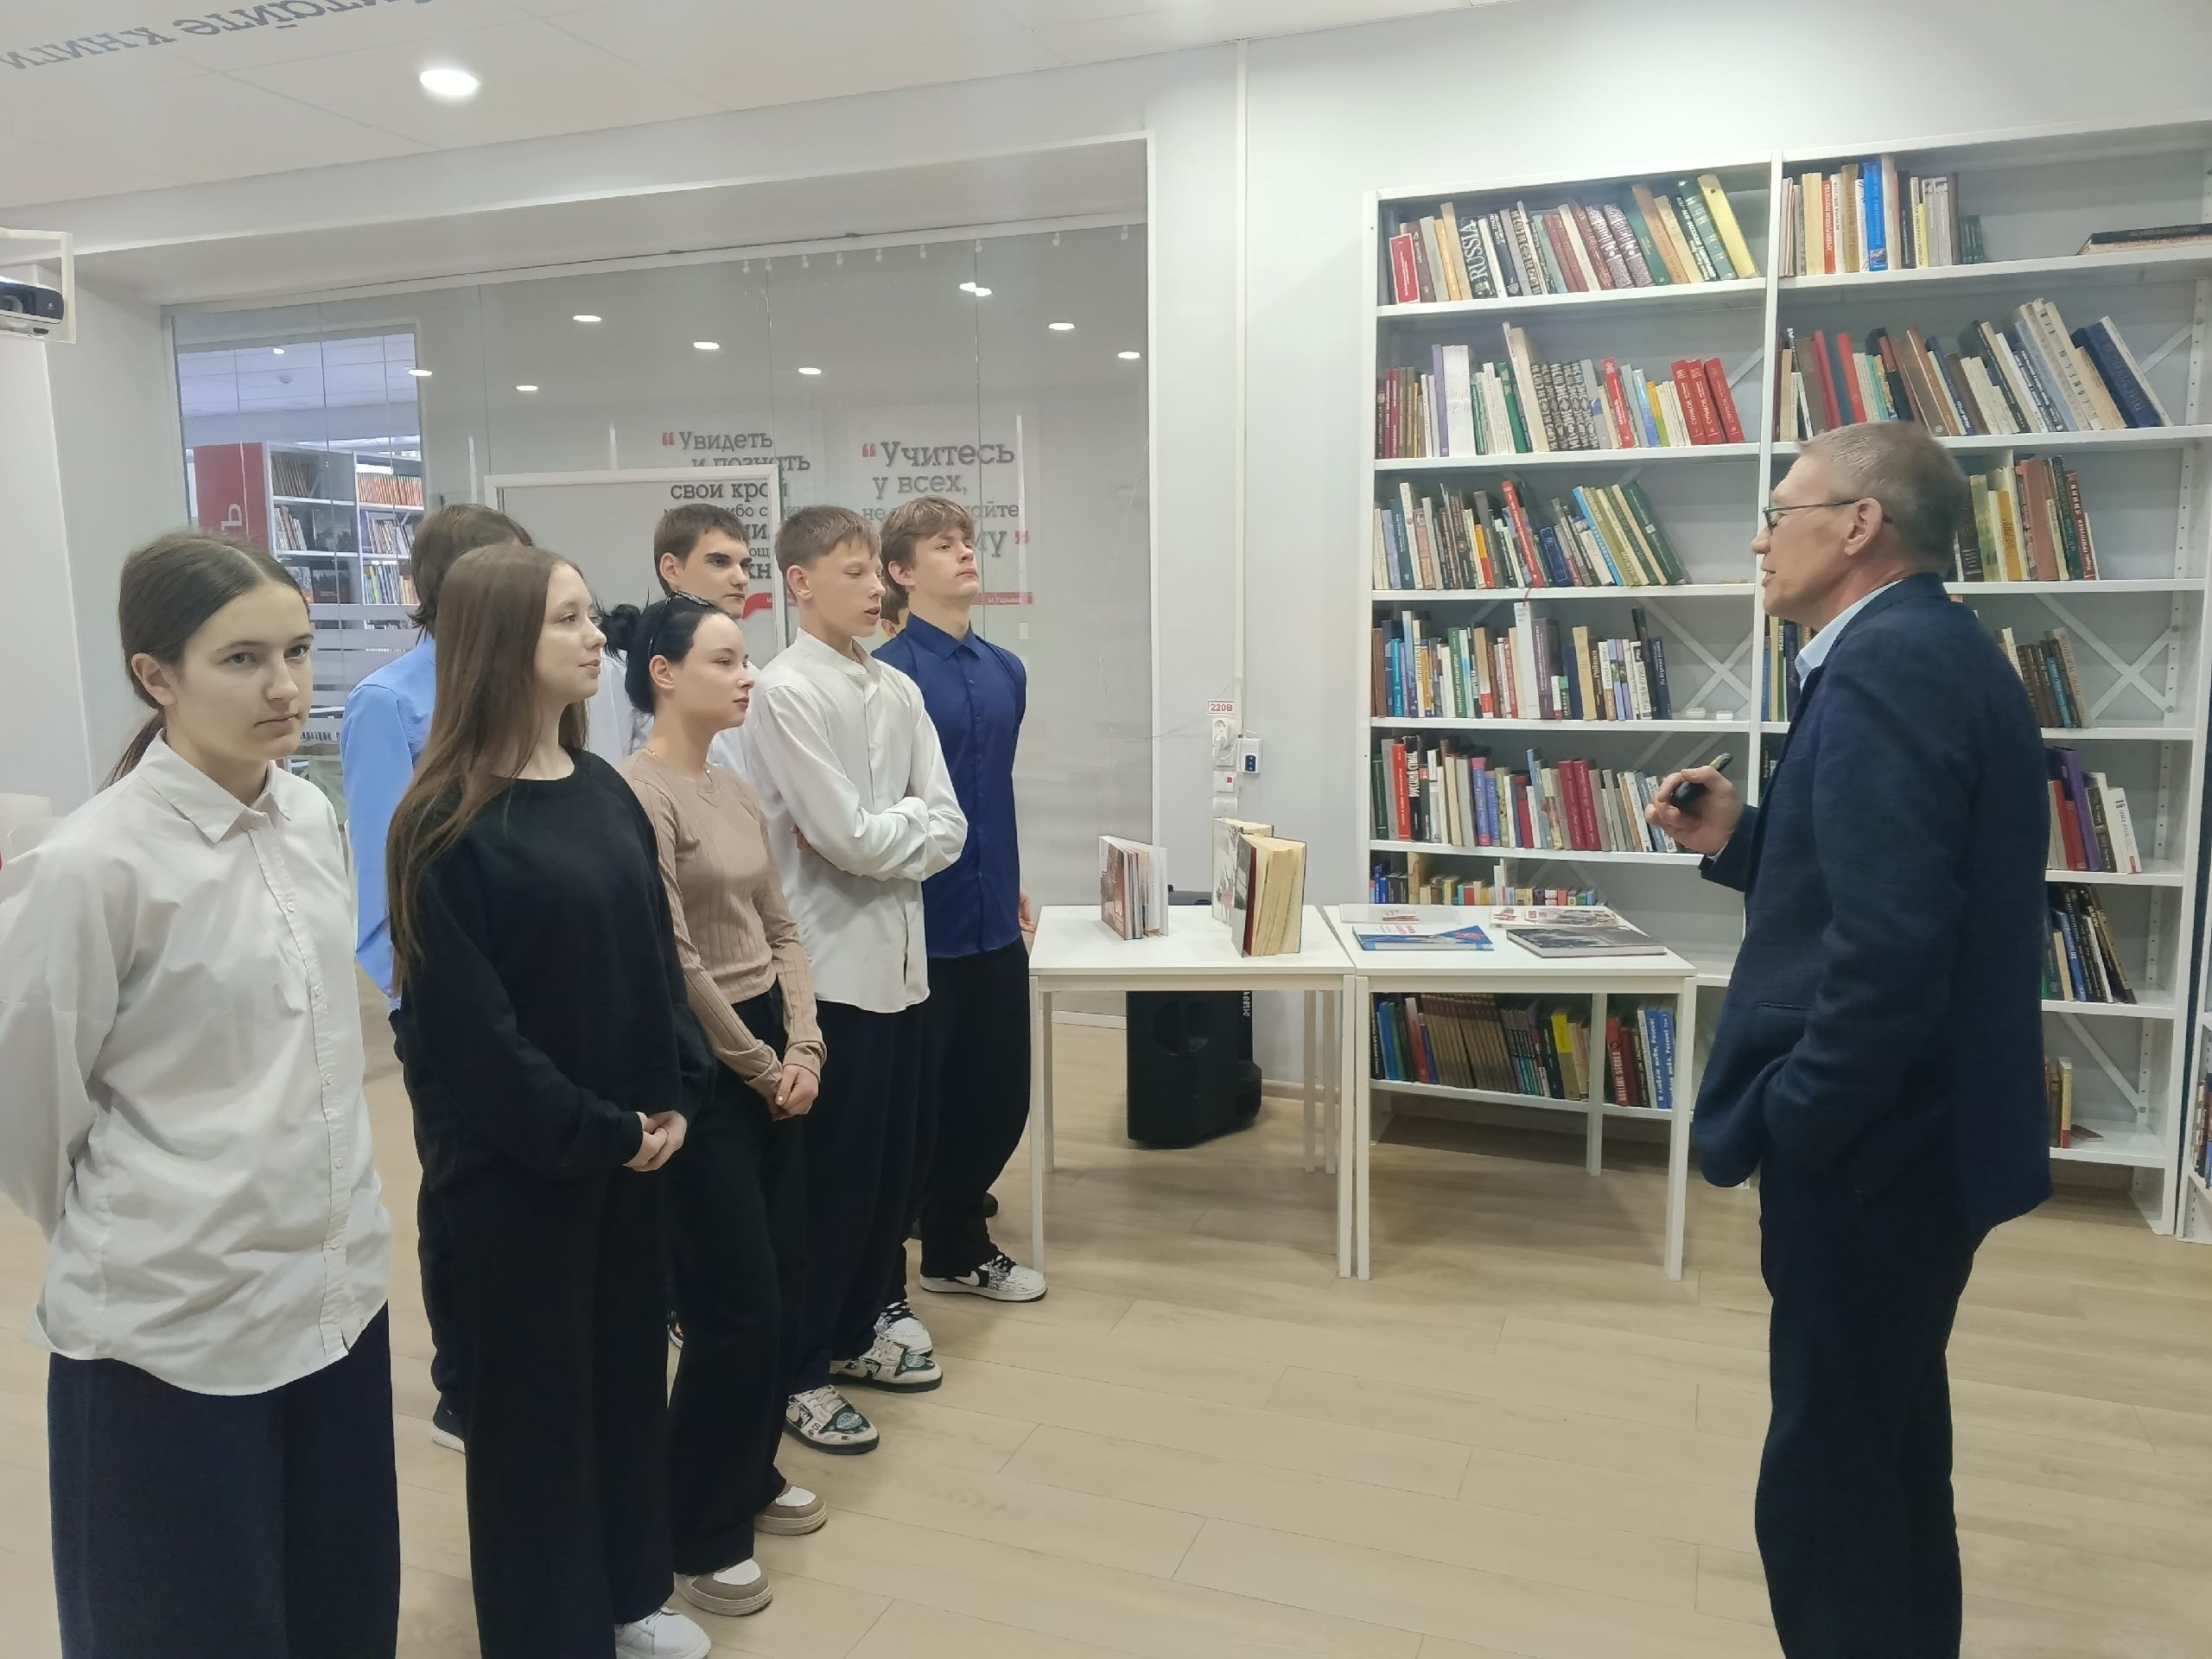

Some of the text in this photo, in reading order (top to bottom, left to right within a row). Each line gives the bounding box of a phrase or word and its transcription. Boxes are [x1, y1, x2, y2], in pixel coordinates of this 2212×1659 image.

[1466, 219, 1490, 283] RUSSIA
[873, 475, 967, 499] у всех,
[1407, 750, 1420, 798] РУССКИЙ СТИЛЬ
[1612, 1052, 1626, 1101] ROLLING STONES
